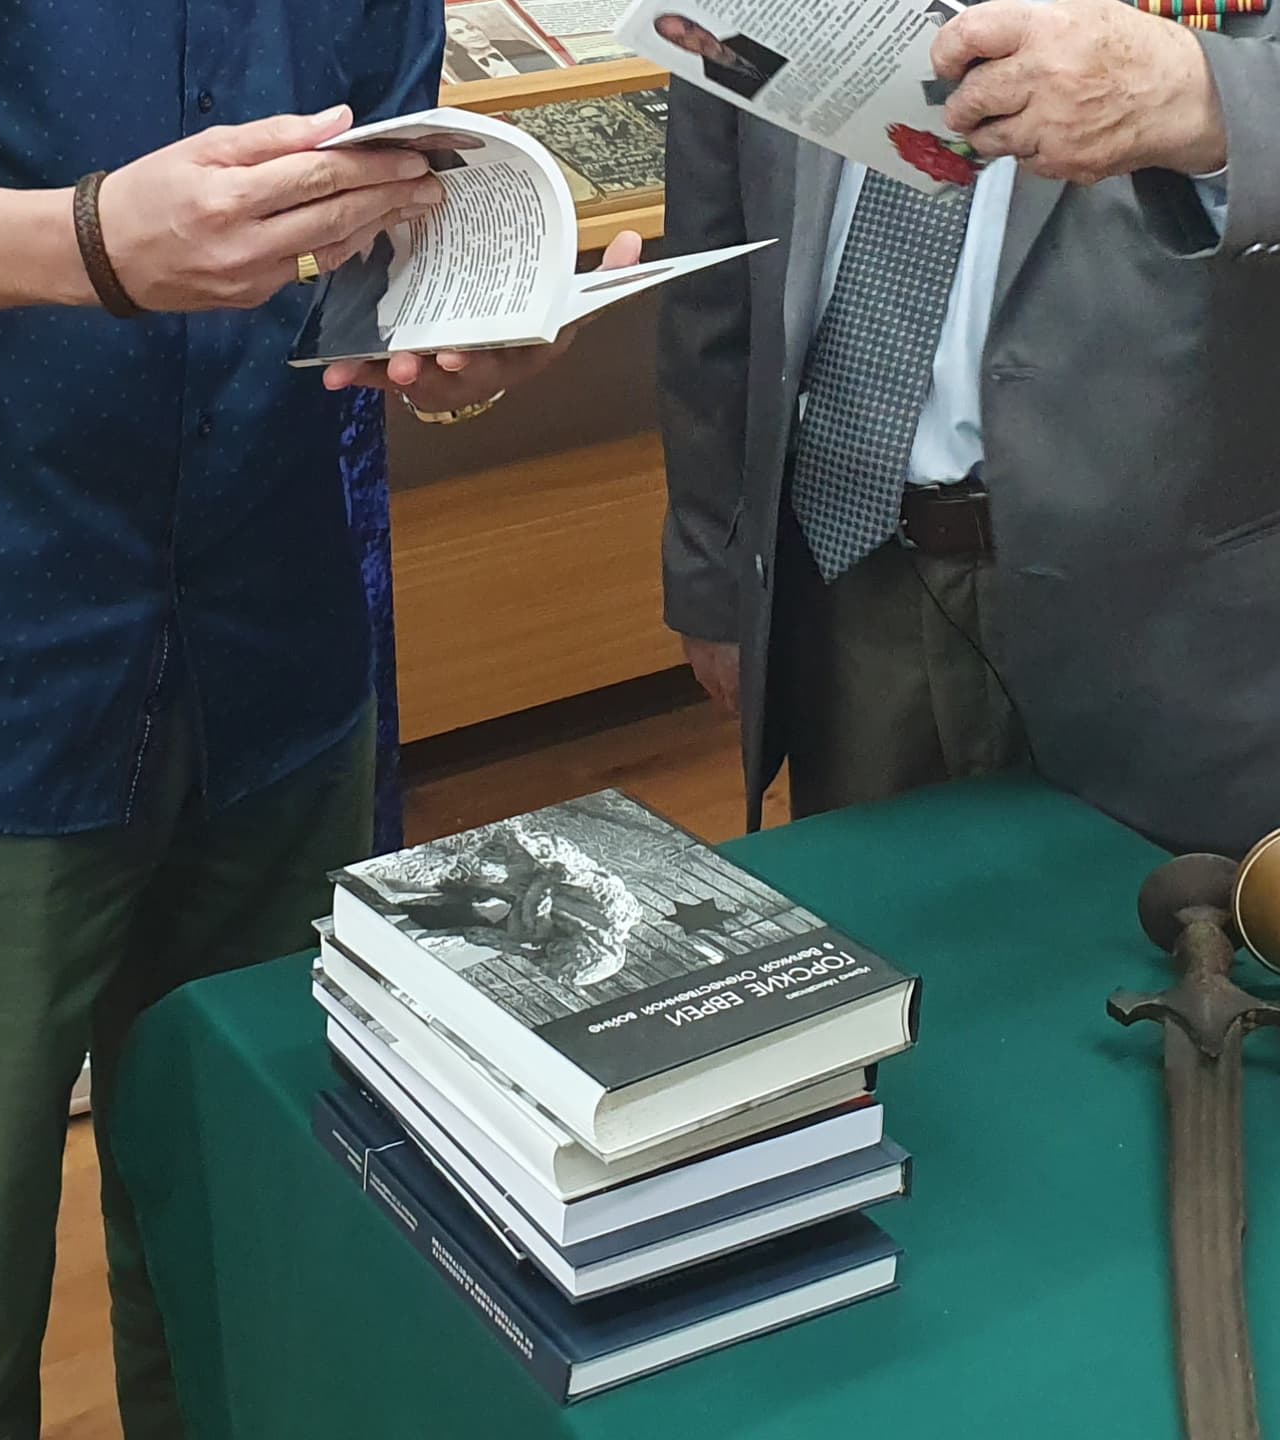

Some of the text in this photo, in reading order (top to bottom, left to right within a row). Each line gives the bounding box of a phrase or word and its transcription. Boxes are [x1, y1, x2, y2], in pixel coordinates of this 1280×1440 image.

[759, 946, 824, 973] Великой
[640, 969, 757, 1017] Отечественной
[664, 951, 856, 1027] ГОРСКИЕ ЕВРЕИ
[588, 1011, 638, 1034] войне
